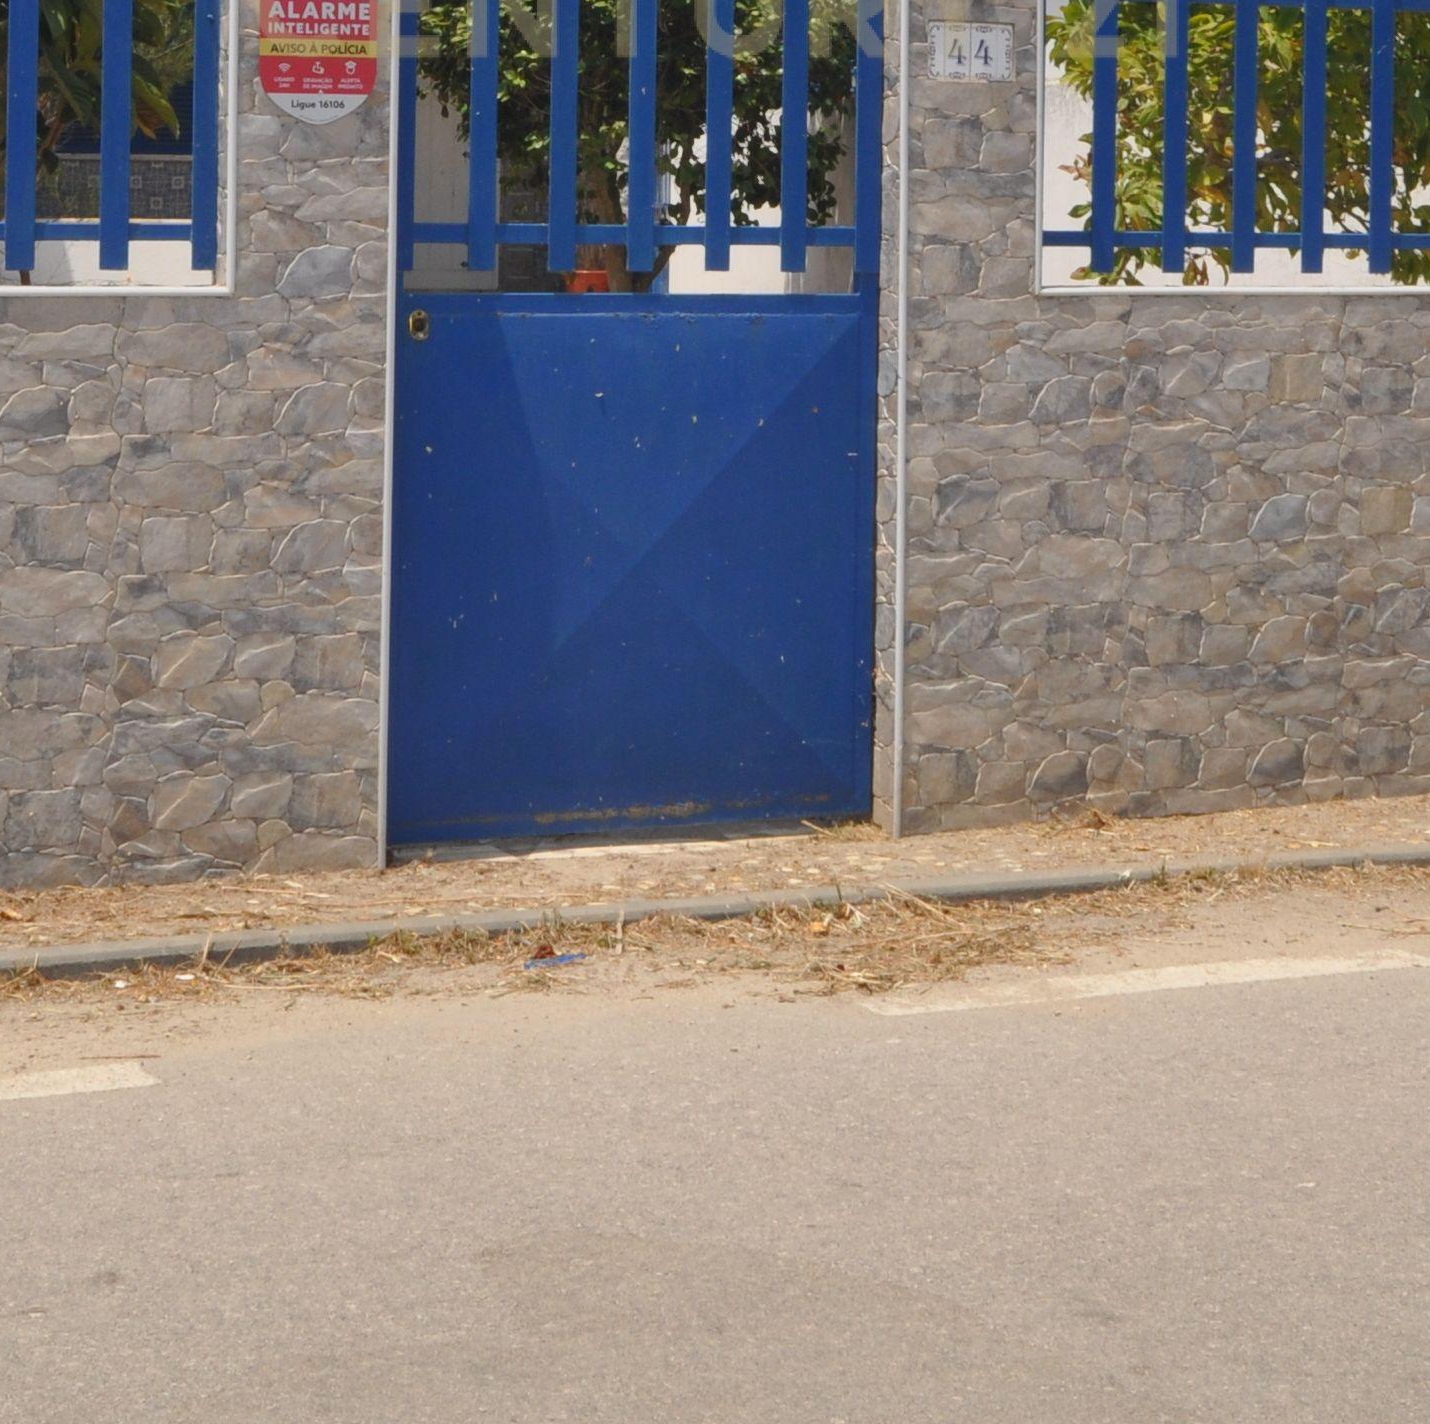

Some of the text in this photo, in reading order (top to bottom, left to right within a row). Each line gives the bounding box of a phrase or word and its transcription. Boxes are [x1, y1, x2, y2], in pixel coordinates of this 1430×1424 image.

[268, 0, 371, 21] ALARME
[268, 21, 370, 36] INTELIGENTE
[270, 40, 368, 55] AVISO À POLÍCIA
[946, 38, 993, 65] 44
[291, 99, 346, 111] Ligue 16106
